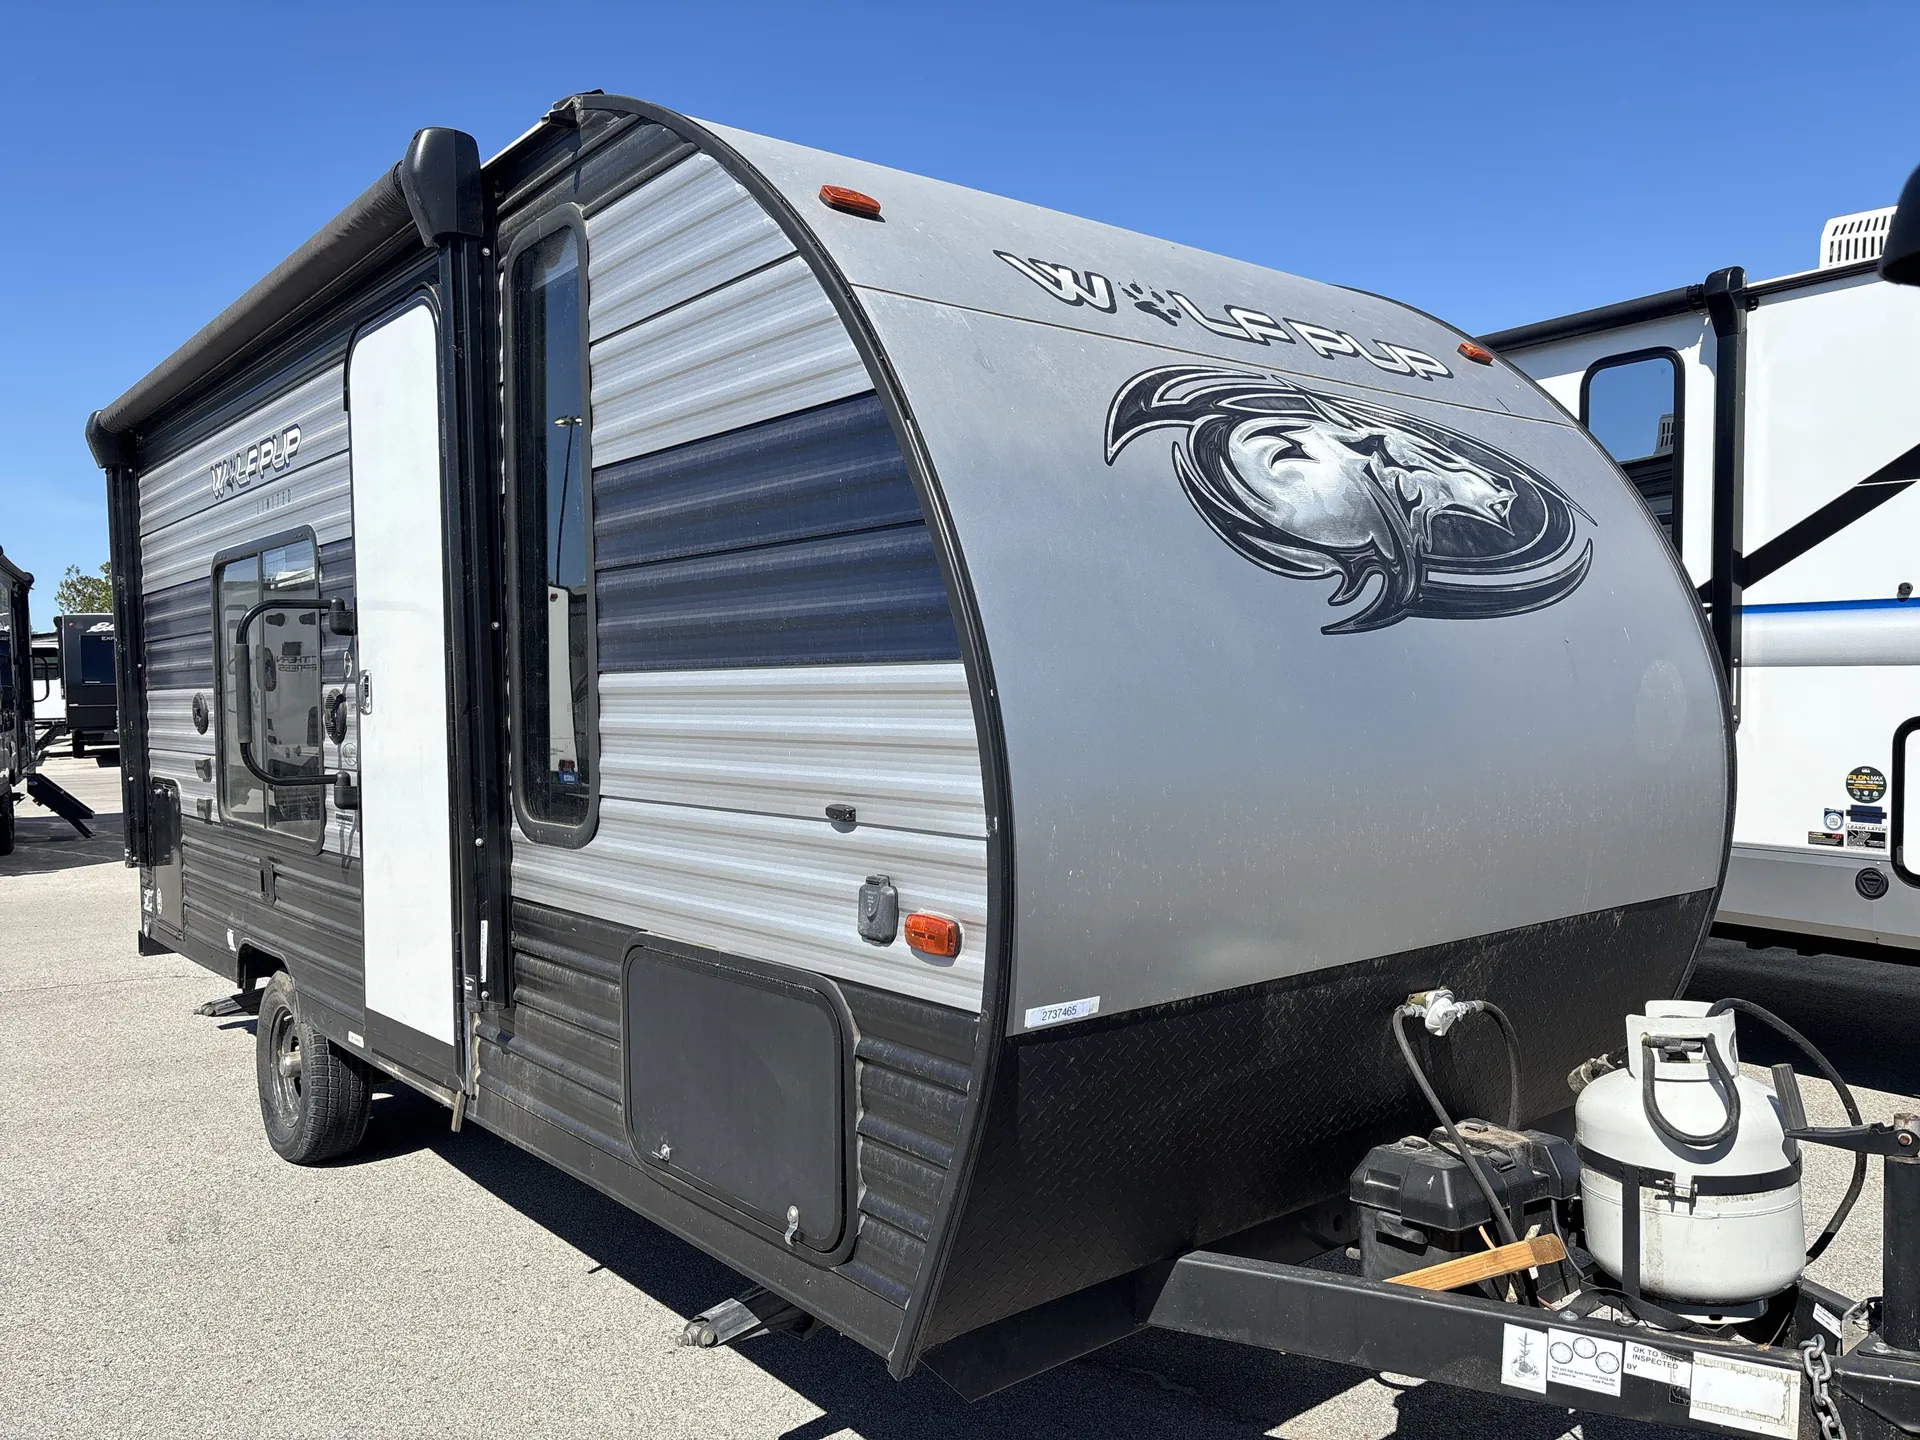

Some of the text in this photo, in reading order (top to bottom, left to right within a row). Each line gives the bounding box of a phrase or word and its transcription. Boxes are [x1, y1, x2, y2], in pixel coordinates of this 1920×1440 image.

[1041, 1005, 1077, 1021] 2737465
[1633, 1346, 1645, 1354] OK
[1647, 1349, 1659, 1357] TO
[1632, 1353, 1679, 1370] INSPECTED
